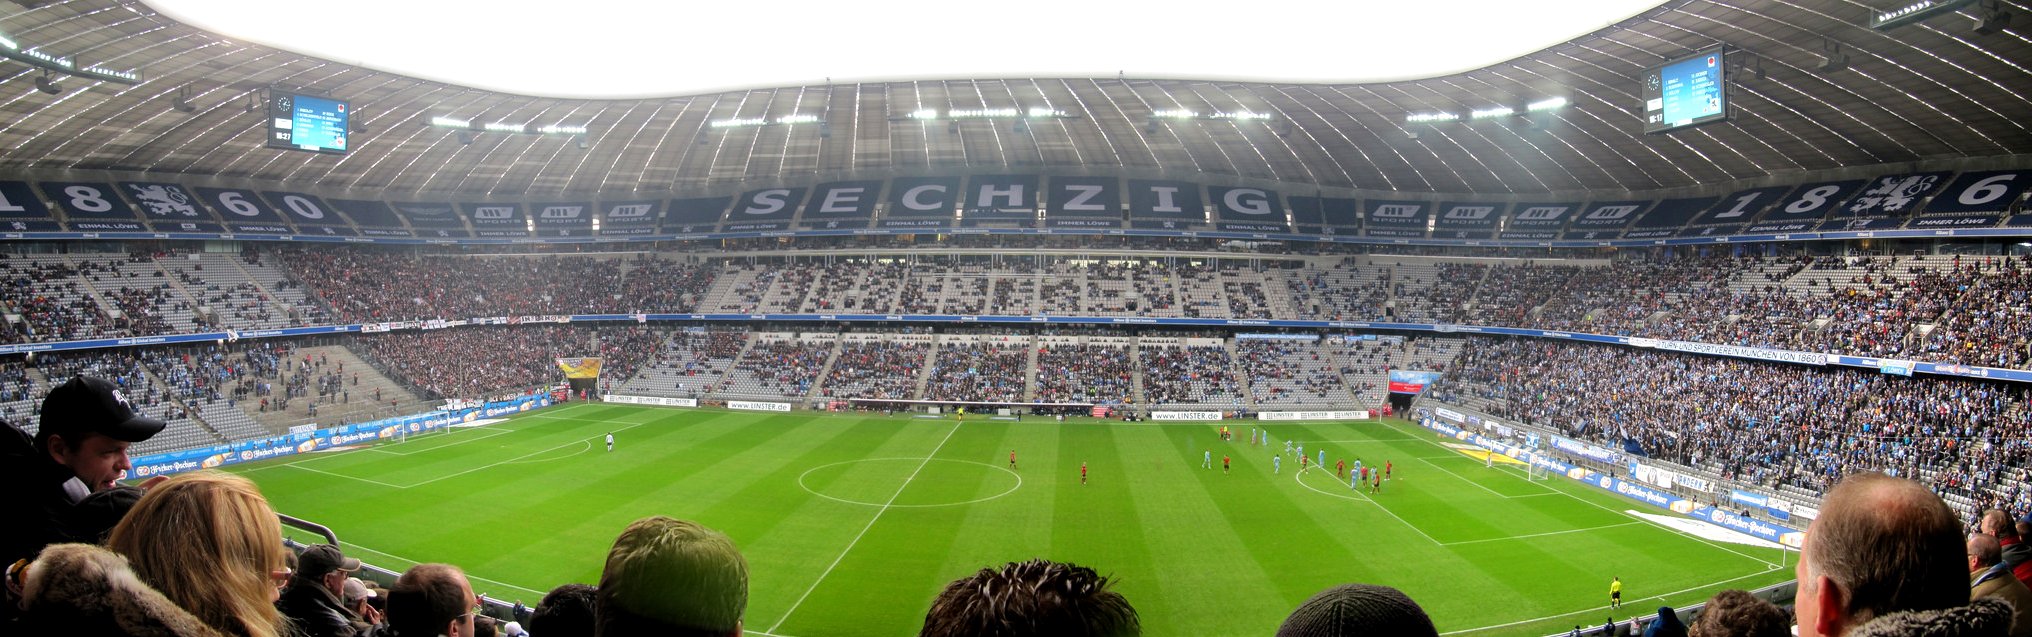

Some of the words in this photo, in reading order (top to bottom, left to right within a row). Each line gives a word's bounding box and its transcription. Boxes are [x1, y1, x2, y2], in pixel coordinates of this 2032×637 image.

[1693, 344, 1740, 355] SPORTVEREIN
[1779, 352, 1796, 362] VON
[1797, 353, 1817, 363] 1860
[731, 401, 787, 410] www.LINSTER.de
[1156, 412, 1218, 420] www.LINSTER.de
[1724, 513, 1777, 538] Hacker-Pschorr
